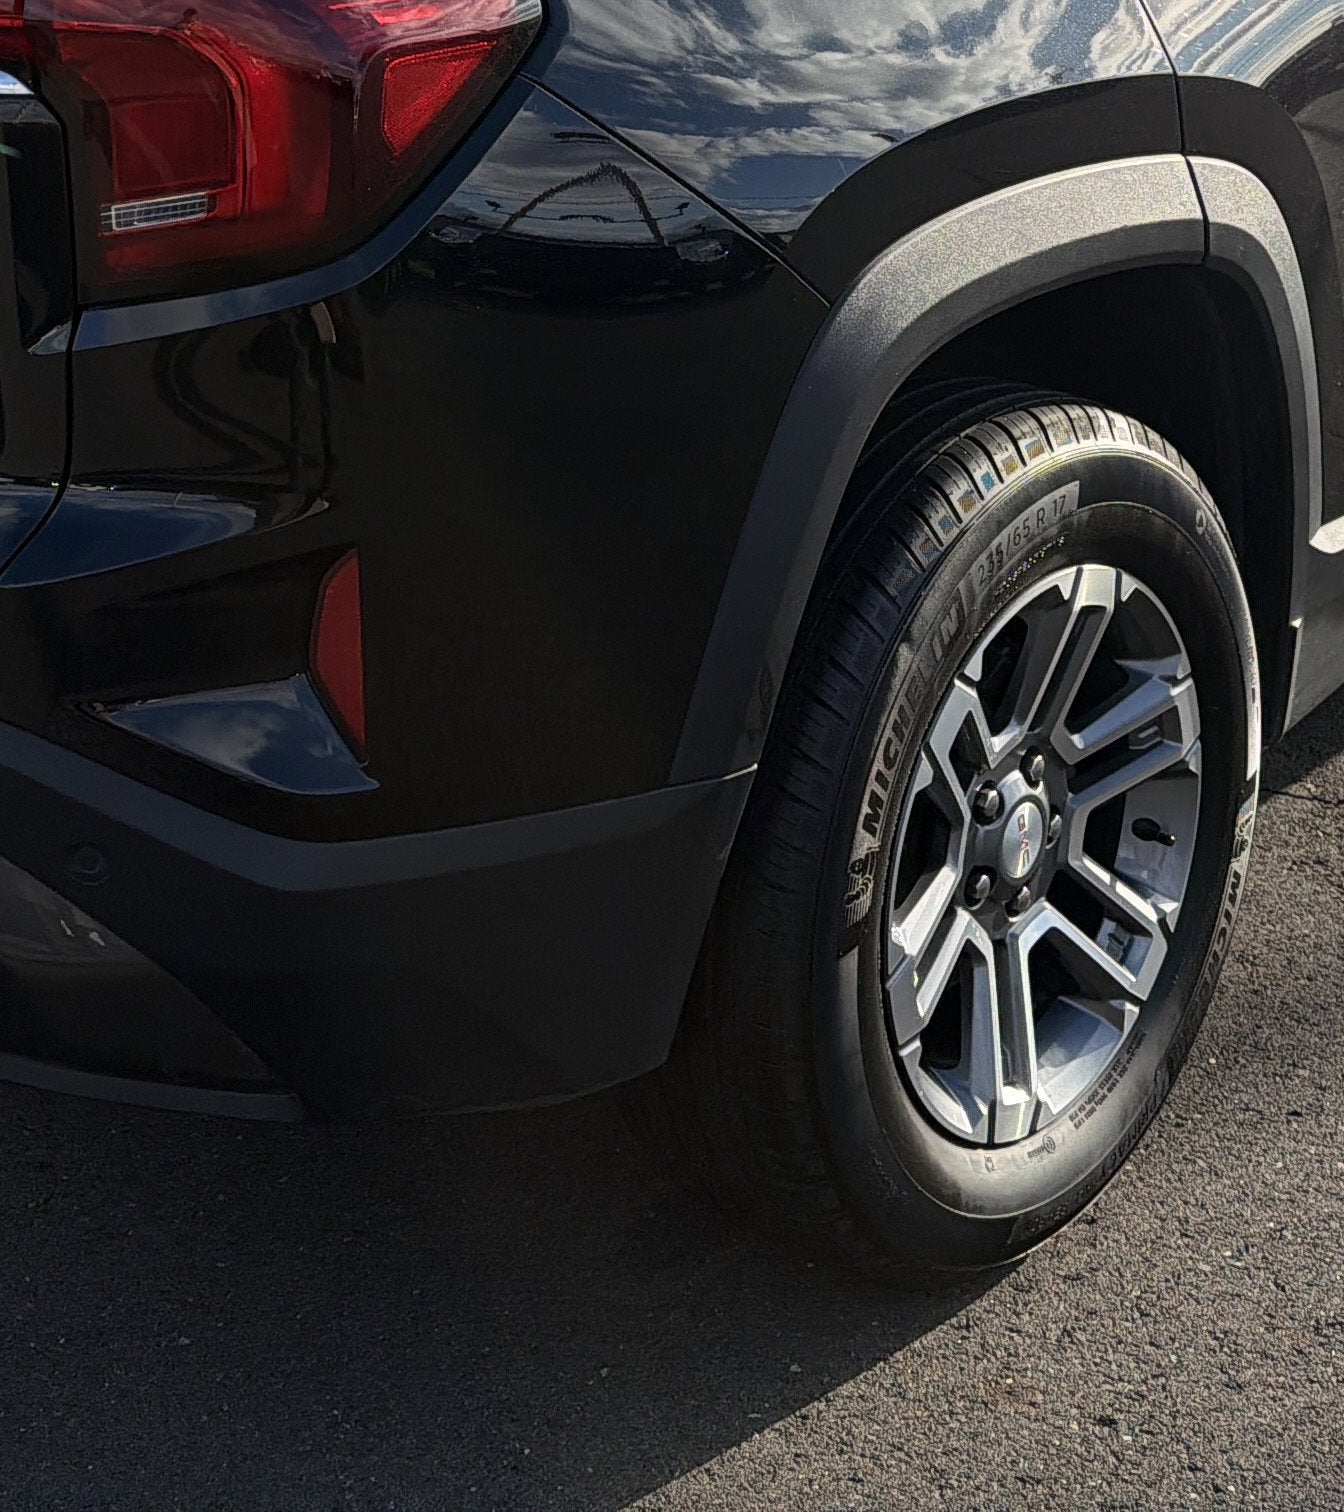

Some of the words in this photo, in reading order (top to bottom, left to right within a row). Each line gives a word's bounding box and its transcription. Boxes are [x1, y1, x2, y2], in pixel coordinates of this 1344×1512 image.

[977, 517, 1031, 586] 235/65
[1036, 507, 1047, 529] R
[1052, 494, 1067, 517] 17
[862, 600, 961, 839] MICHELIN
